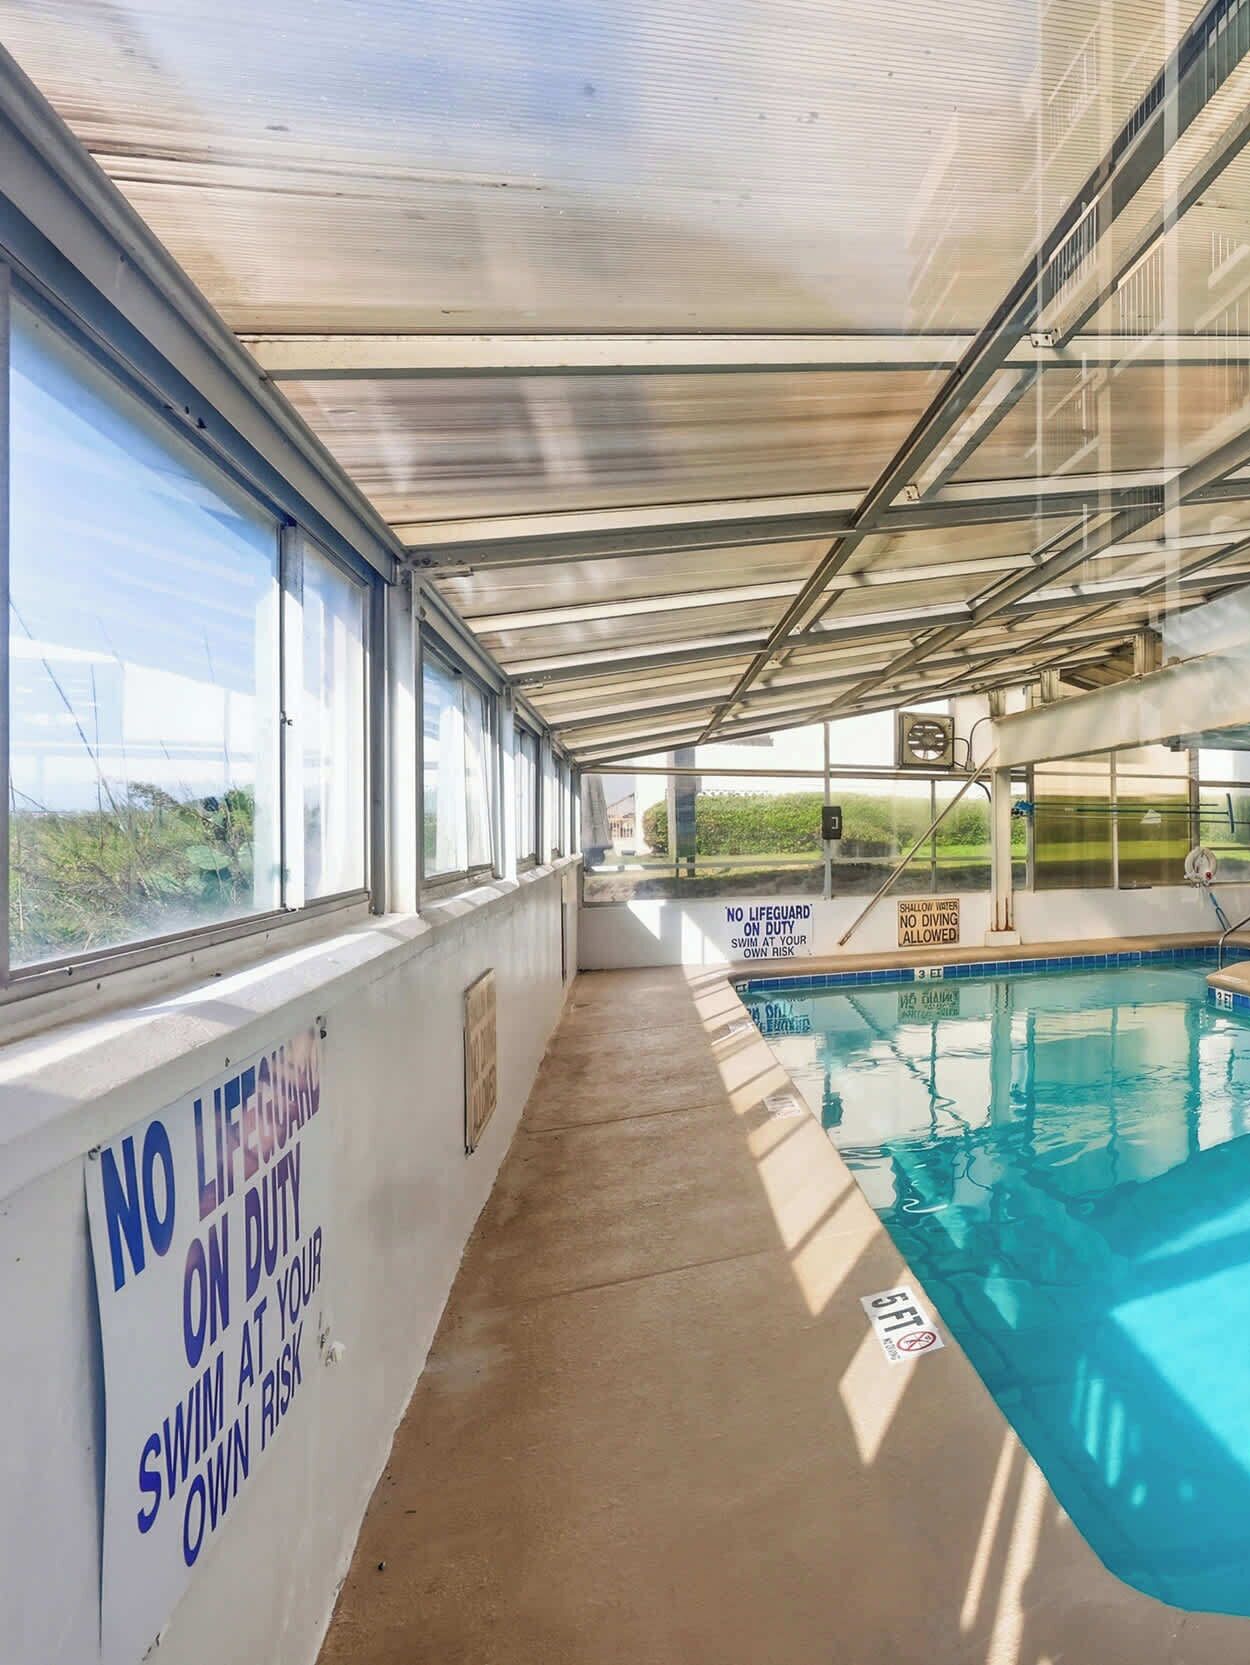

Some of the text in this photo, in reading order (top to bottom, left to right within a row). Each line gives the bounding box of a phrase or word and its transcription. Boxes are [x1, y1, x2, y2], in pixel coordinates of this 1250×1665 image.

[727, 905, 810, 922] NO LIFEGUARD
[900, 901, 958, 913] SHALLOW WATER
[744, 920, 795, 936] ON DUTY
[900, 912, 958, 928] NO DIVING
[731, 935, 807, 948] SWIM AT YOUR
[903, 928, 957, 944] ALLOWED
[744, 946, 794, 958] OWN RISK
[918, 970, 925, 979] 3
[100, 1120, 176, 1292] NO
[193, 1038, 320, 1222] LIFEGUARD
[183, 1140, 301, 1369] ON DUTY
[871, 1292, 925, 1332] 5 FT
[137, 1225, 322, 1534] SWIM AT YOUR
[183, 1319, 303, 1568] OWN RISK
